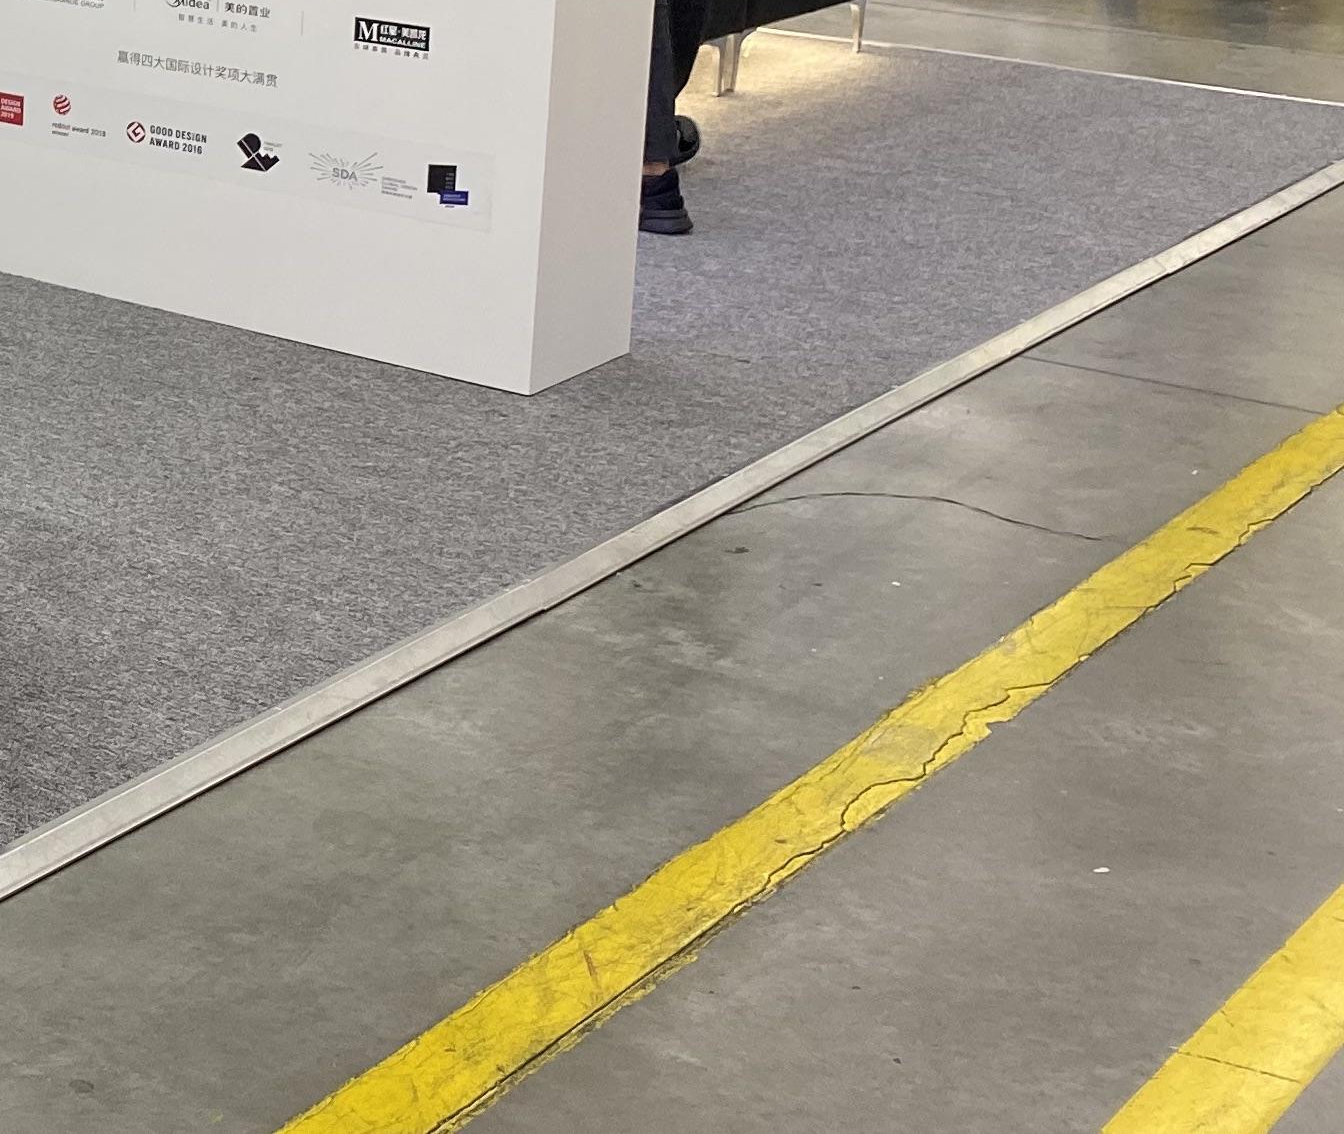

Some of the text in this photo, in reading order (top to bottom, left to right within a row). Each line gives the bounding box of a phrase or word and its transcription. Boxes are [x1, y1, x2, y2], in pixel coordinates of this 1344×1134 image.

[81, 0, 106, 10] GROUP
[224, 1, 271, 19] 美的置业
[358, 19, 381, 42] M
[117, 50, 279, 89] 赢得四大国际设计奖项大满贯
[150, 124, 208, 144] GOOD DESIGN
[149, 137, 180, 151] AWARD
[331, 166, 359, 182] SDA
